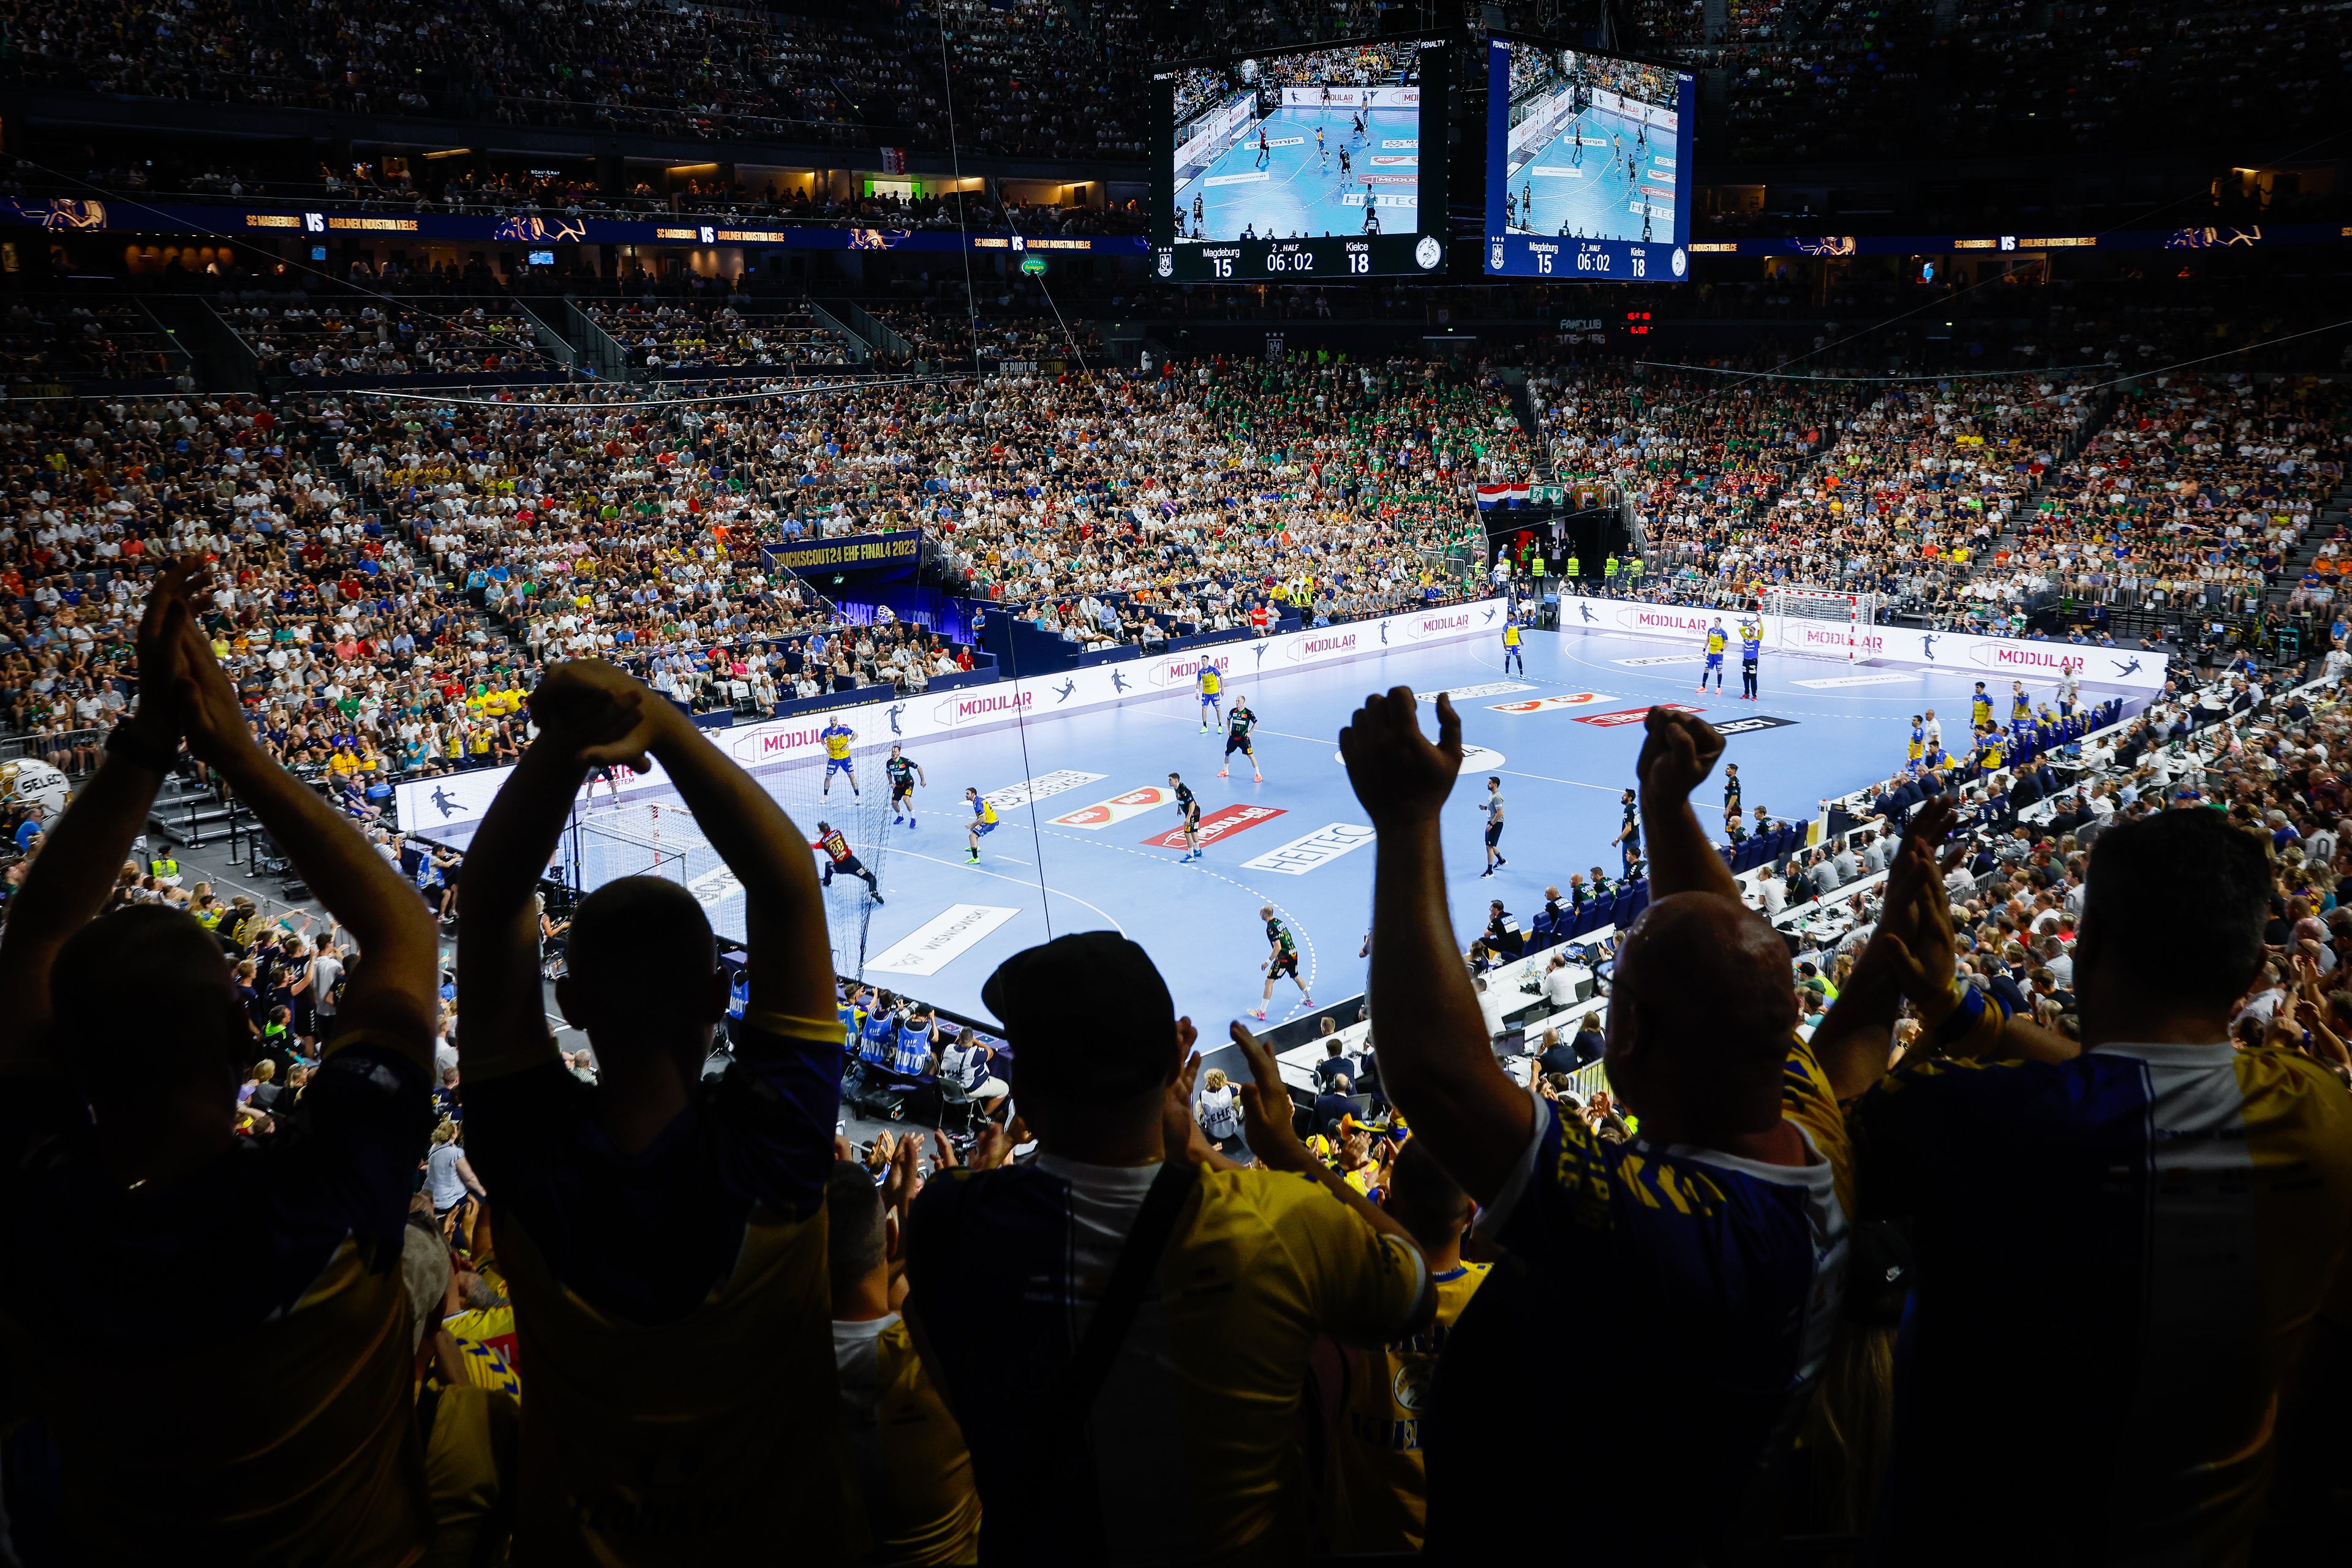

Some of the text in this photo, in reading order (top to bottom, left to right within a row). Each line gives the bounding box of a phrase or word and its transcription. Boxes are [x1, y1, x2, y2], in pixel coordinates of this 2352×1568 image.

[1421, 40, 1445, 48] PENALTY
[1493, 40, 1510, 50] PENALTY
[1679, 74, 1693, 82] PENALTY
[305, 213, 324, 232] VS
[657, 227, 784, 243] SC MAGDEBURG VS BARLINEK INDUSTRIA KIELCE
[974, 236, 1091, 251] SC MAGDEBURG VS BARLINEK INDUSTRIA KIELCE
[2000, 236, 2016, 251] VS
[1202, 248, 1240, 259] Magdeburg
[1272, 244, 1277, 252] 2
[1346, 242, 1368, 252] Kielce
[1529, 241, 1558, 255] Magdeburg
[1581, 243, 1586, 252] 2
[1630, 247, 1645, 257] Kielce
[1692, 243, 1720, 252] INDUSTRIA
[1720, 243, 1738, 252] KIELCE
[1213, 258, 1232, 277] 15
[1267, 252, 1313, 271] 06:02
[1348, 253, 1369, 273] 18
[1537, 254, 1552, 274] 15
[1577, 253, 1610, 271] 06:02
[1632, 258, 1645, 277] 18
[773, 547, 842, 568] TRUCKSCOUT24
[843, 545, 859, 562] EHF
[893, 539, 916, 556] 2023
[1423, 614, 1468, 632] MODULAR
[1639, 613, 1706, 631] MODULAR
[1305, 634, 1356, 654] MODULAR
[1807, 630, 1882, 649] MODULAR
[1999, 649, 2083, 670] MODULAR
[959, 692, 1031, 717] MODULAR
[1003, 770, 1078, 795] MACHINE
[1031, 775, 1094, 797] SEEKER
[1118, 791, 1152, 805] MOL
[1065, 810, 1101, 824] MOL
[1196, 806, 1272, 839] MODULAR
[1255, 825, 1376, 872] HEITEC
[869, 1027, 881, 1036] EHF
[904, 1039, 918, 1048] EHF
[1210, 1107, 1231, 1123] EHF
